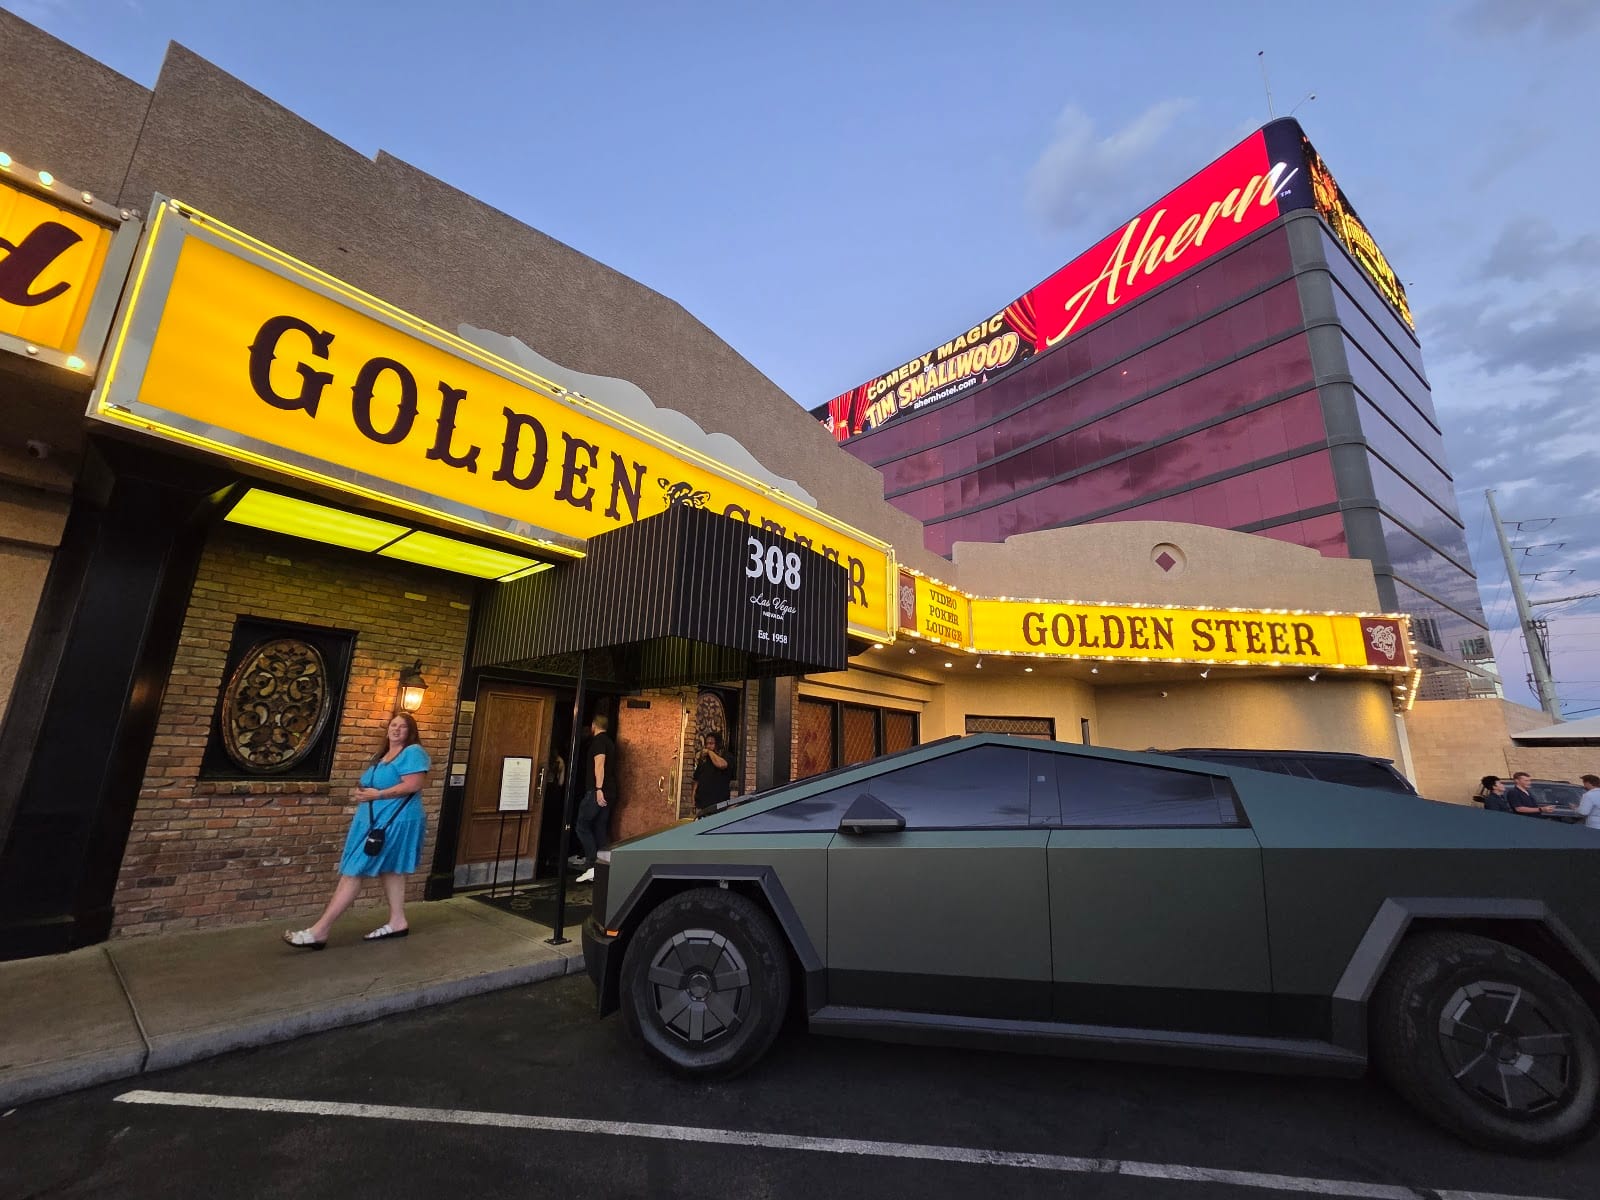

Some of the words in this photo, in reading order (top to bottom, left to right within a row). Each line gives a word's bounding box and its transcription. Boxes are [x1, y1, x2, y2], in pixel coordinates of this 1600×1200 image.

[1046, 162, 1298, 347] Ahern
[867, 351, 933, 400] COMEDY
[937, 314, 1002, 360] MAGIC
[865, 391, 898, 429] TIM
[897, 332, 1020, 409] SMALLWOOD
[247, 314, 648, 523] GOLDEN
[746, 536, 801, 591] 308
[750, 592, 770, 607] Las
[772, 597, 797, 616] Vegas
[762, 610, 784, 620] NEVADA
[928, 604, 960, 626] POKER
[929, 588, 958, 610] VIDEO
[757, 629, 770, 641] Est.
[772, 633, 788, 644] 1958
[925, 618, 963, 642] LOUNGE
[1022, 611, 1175, 650] GOLDEN
[1191, 618, 1321, 657] STEER
